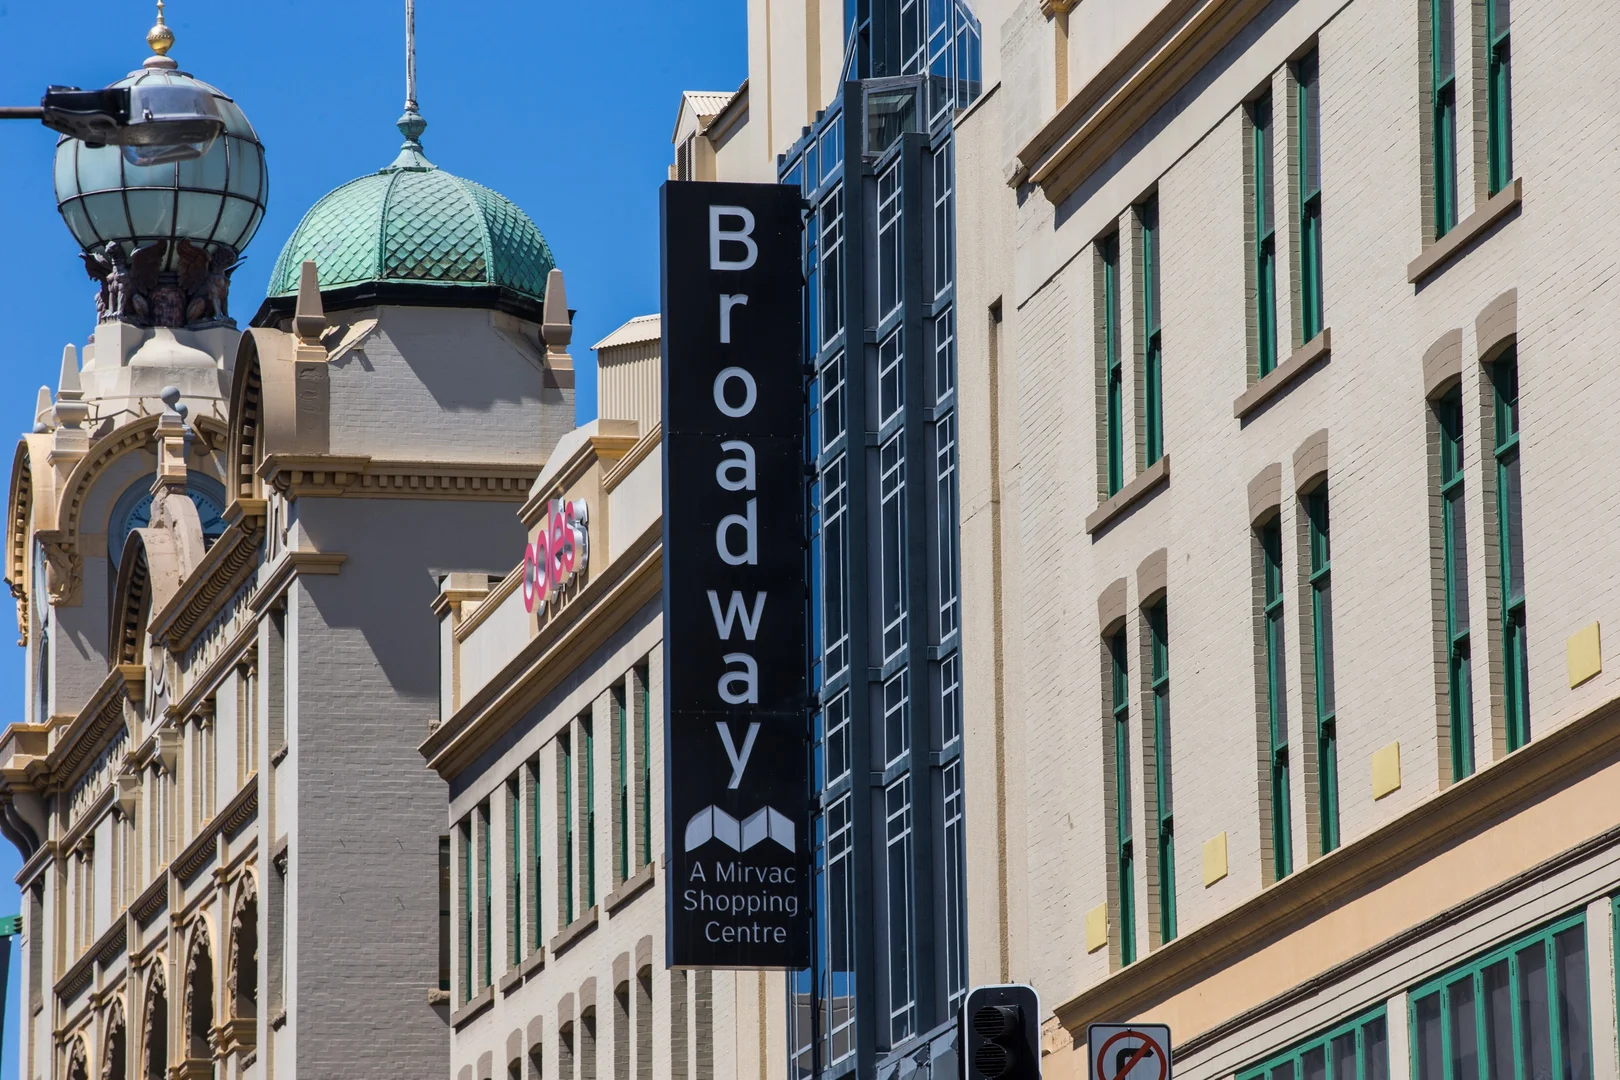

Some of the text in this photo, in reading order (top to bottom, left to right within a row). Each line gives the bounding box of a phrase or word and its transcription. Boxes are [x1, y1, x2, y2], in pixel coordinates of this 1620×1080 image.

[707, 204, 767, 790] Broadway
[523, 499, 577, 613] coles
[689, 861, 796, 883] A Mirvac
[683, 889, 798, 917] Shopping
[705, 921, 787, 943] Centre
